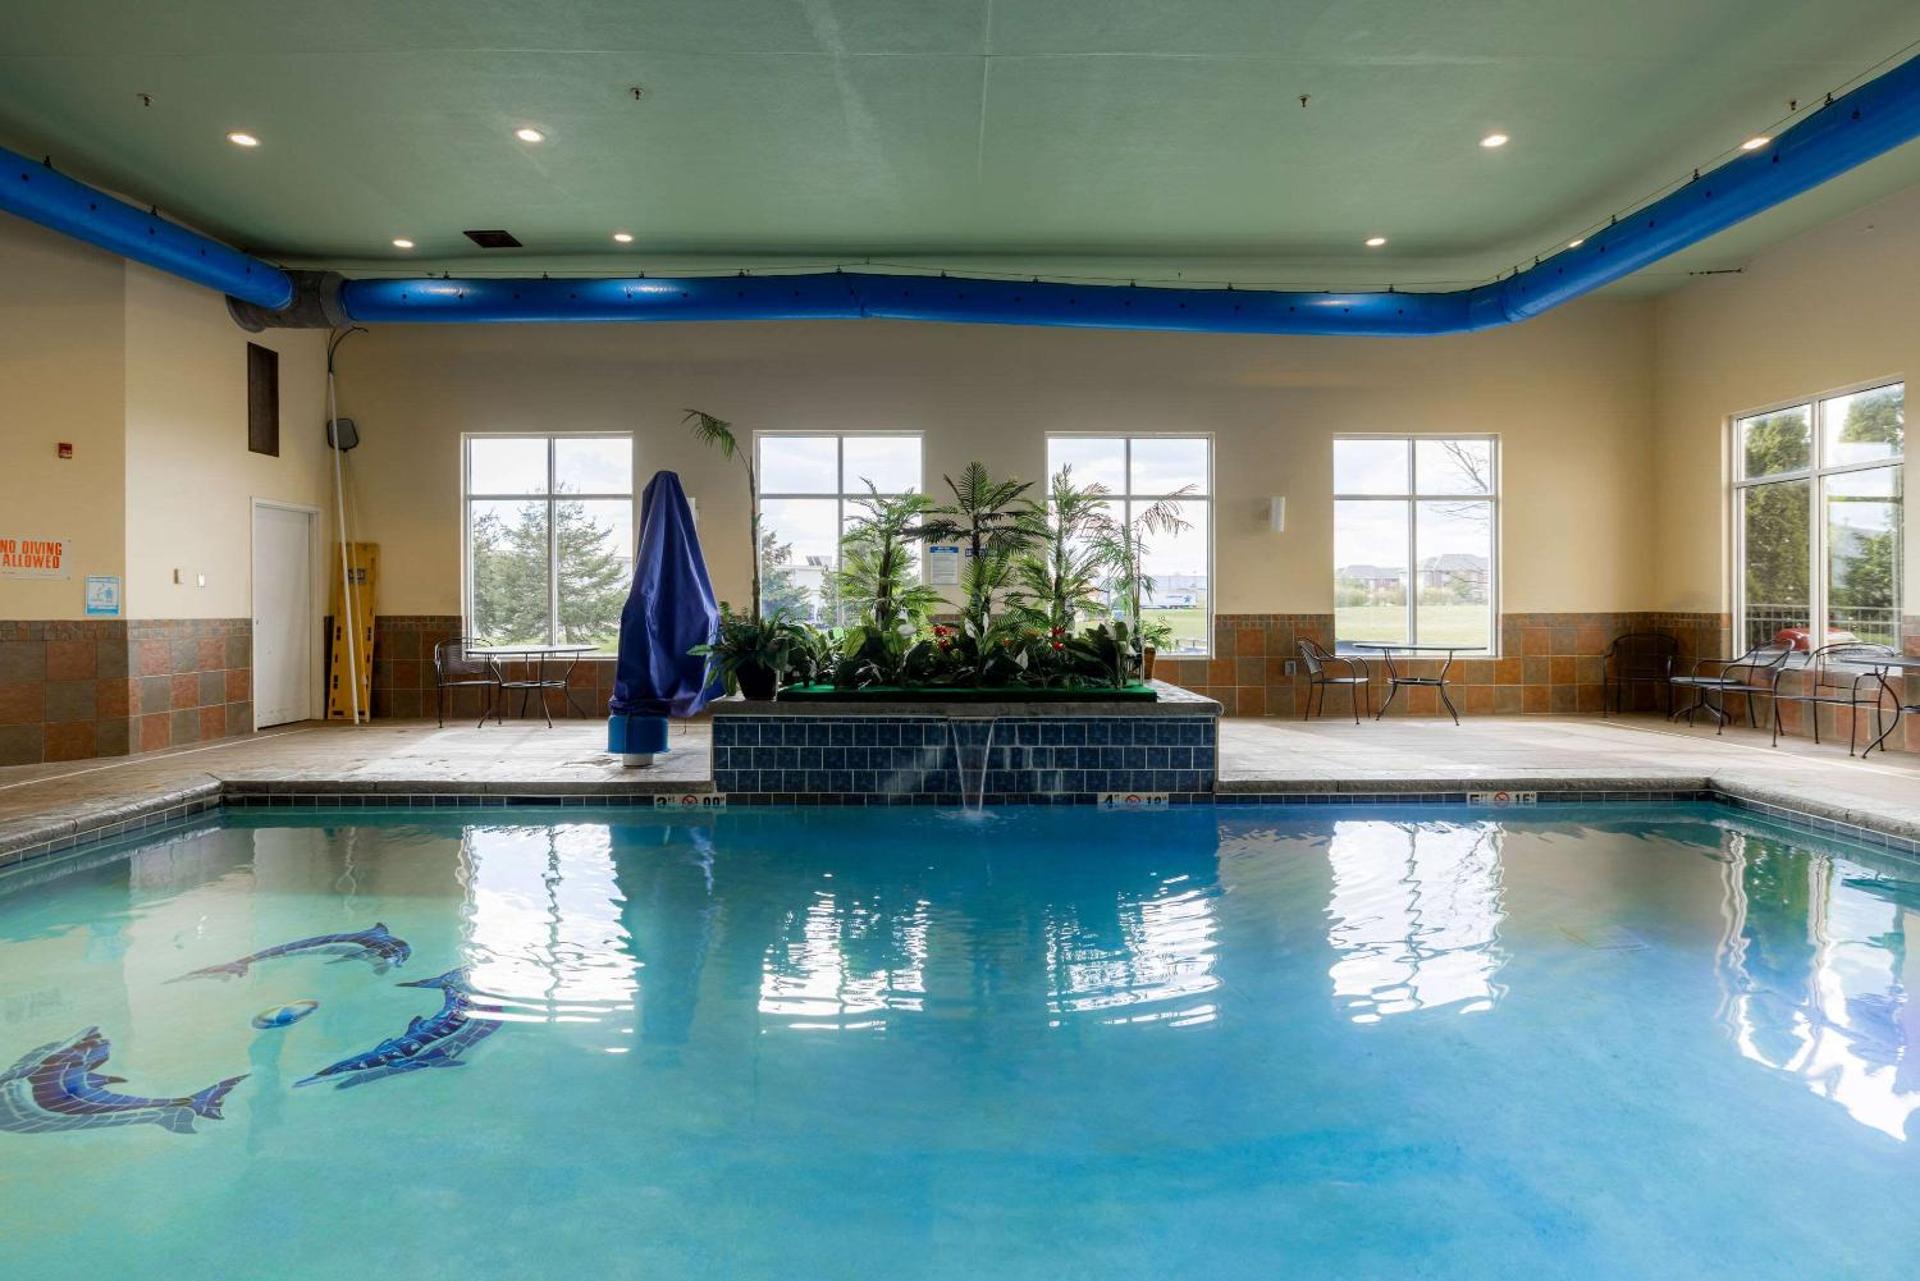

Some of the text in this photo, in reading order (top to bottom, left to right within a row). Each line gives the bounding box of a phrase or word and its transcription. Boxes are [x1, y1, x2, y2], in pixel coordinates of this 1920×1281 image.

[0, 539, 62, 556] NO DIVING
[3, 554, 60, 568] ALLOWED
